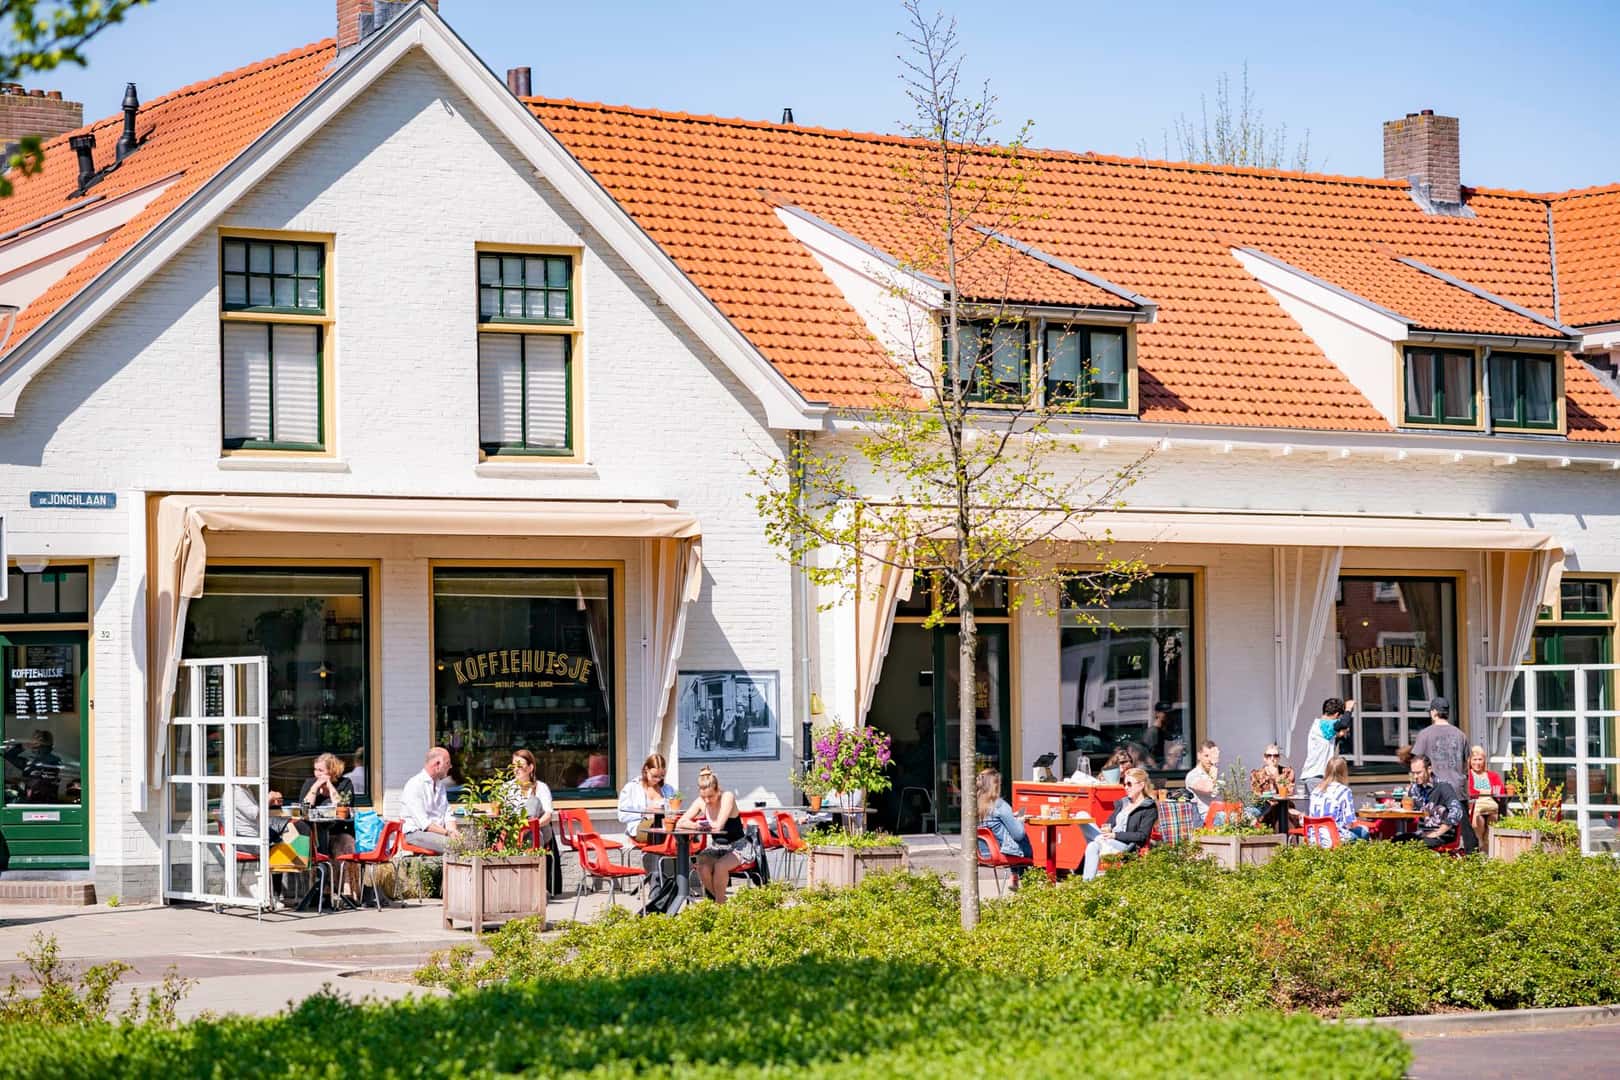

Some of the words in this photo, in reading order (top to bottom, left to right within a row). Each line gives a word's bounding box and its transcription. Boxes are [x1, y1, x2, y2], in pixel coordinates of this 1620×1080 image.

[48, 494, 107, 506] JONGHLAAN
[453, 649, 593, 684] KOFFIEHUISJE
[11, 668, 65, 679] KOFFIEHUISJE
